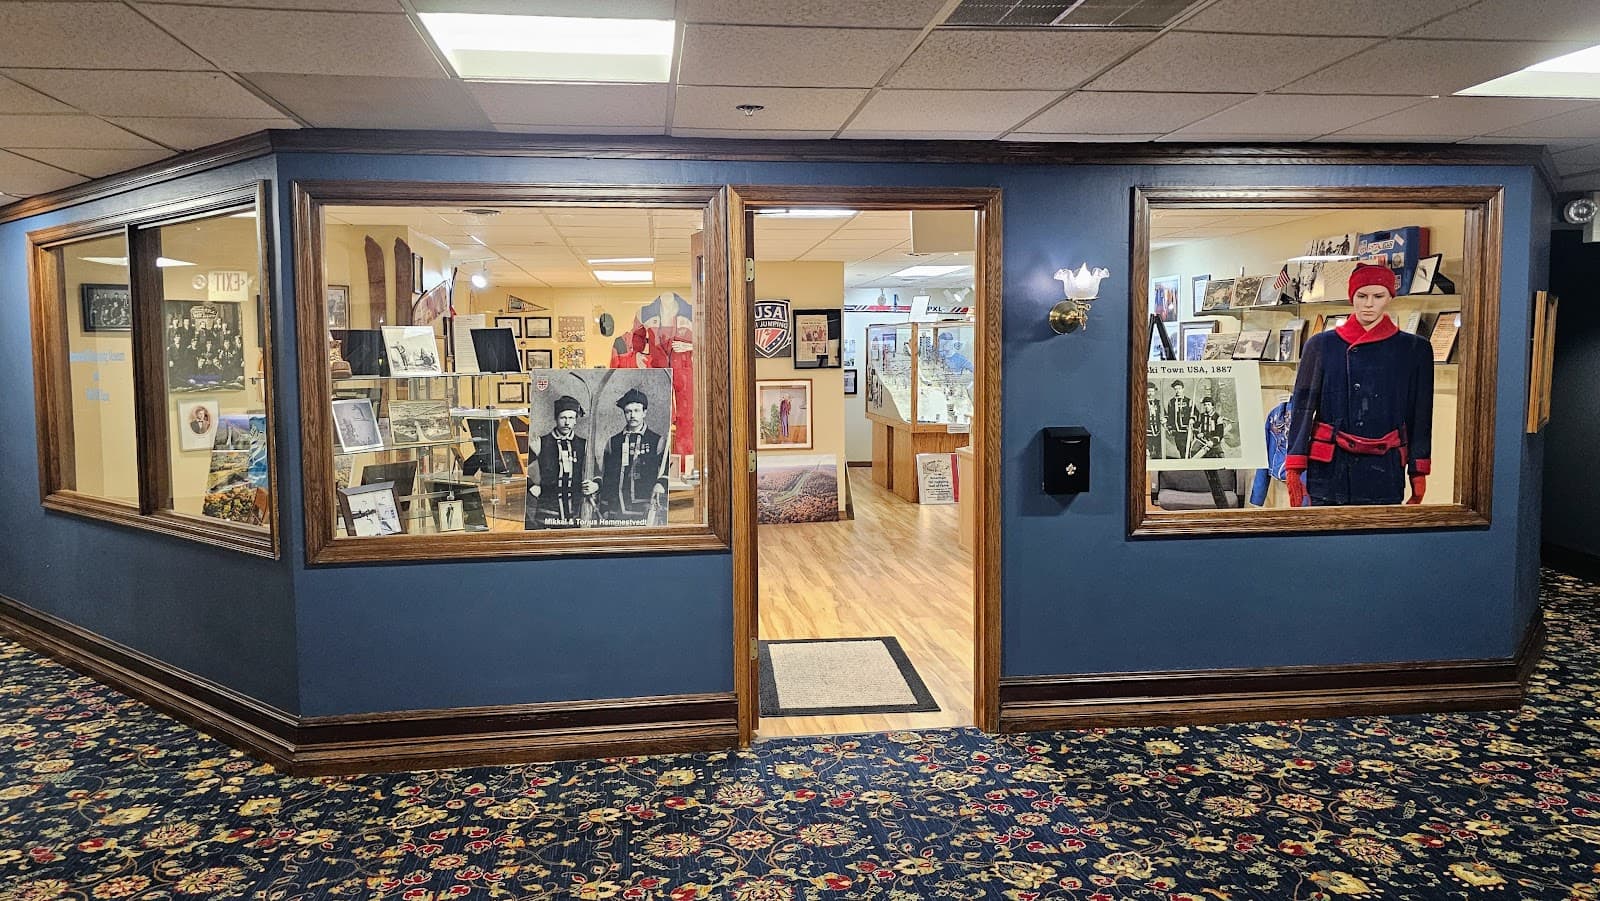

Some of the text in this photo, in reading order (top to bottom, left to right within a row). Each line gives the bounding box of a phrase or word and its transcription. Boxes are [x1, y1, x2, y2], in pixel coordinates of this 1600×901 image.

[759, 320, 789, 329] JUMPING
[1160, 366, 1185, 374] Town
[1187, 366, 1208, 374] USA,
[1211, 365, 1232, 374] 1887
